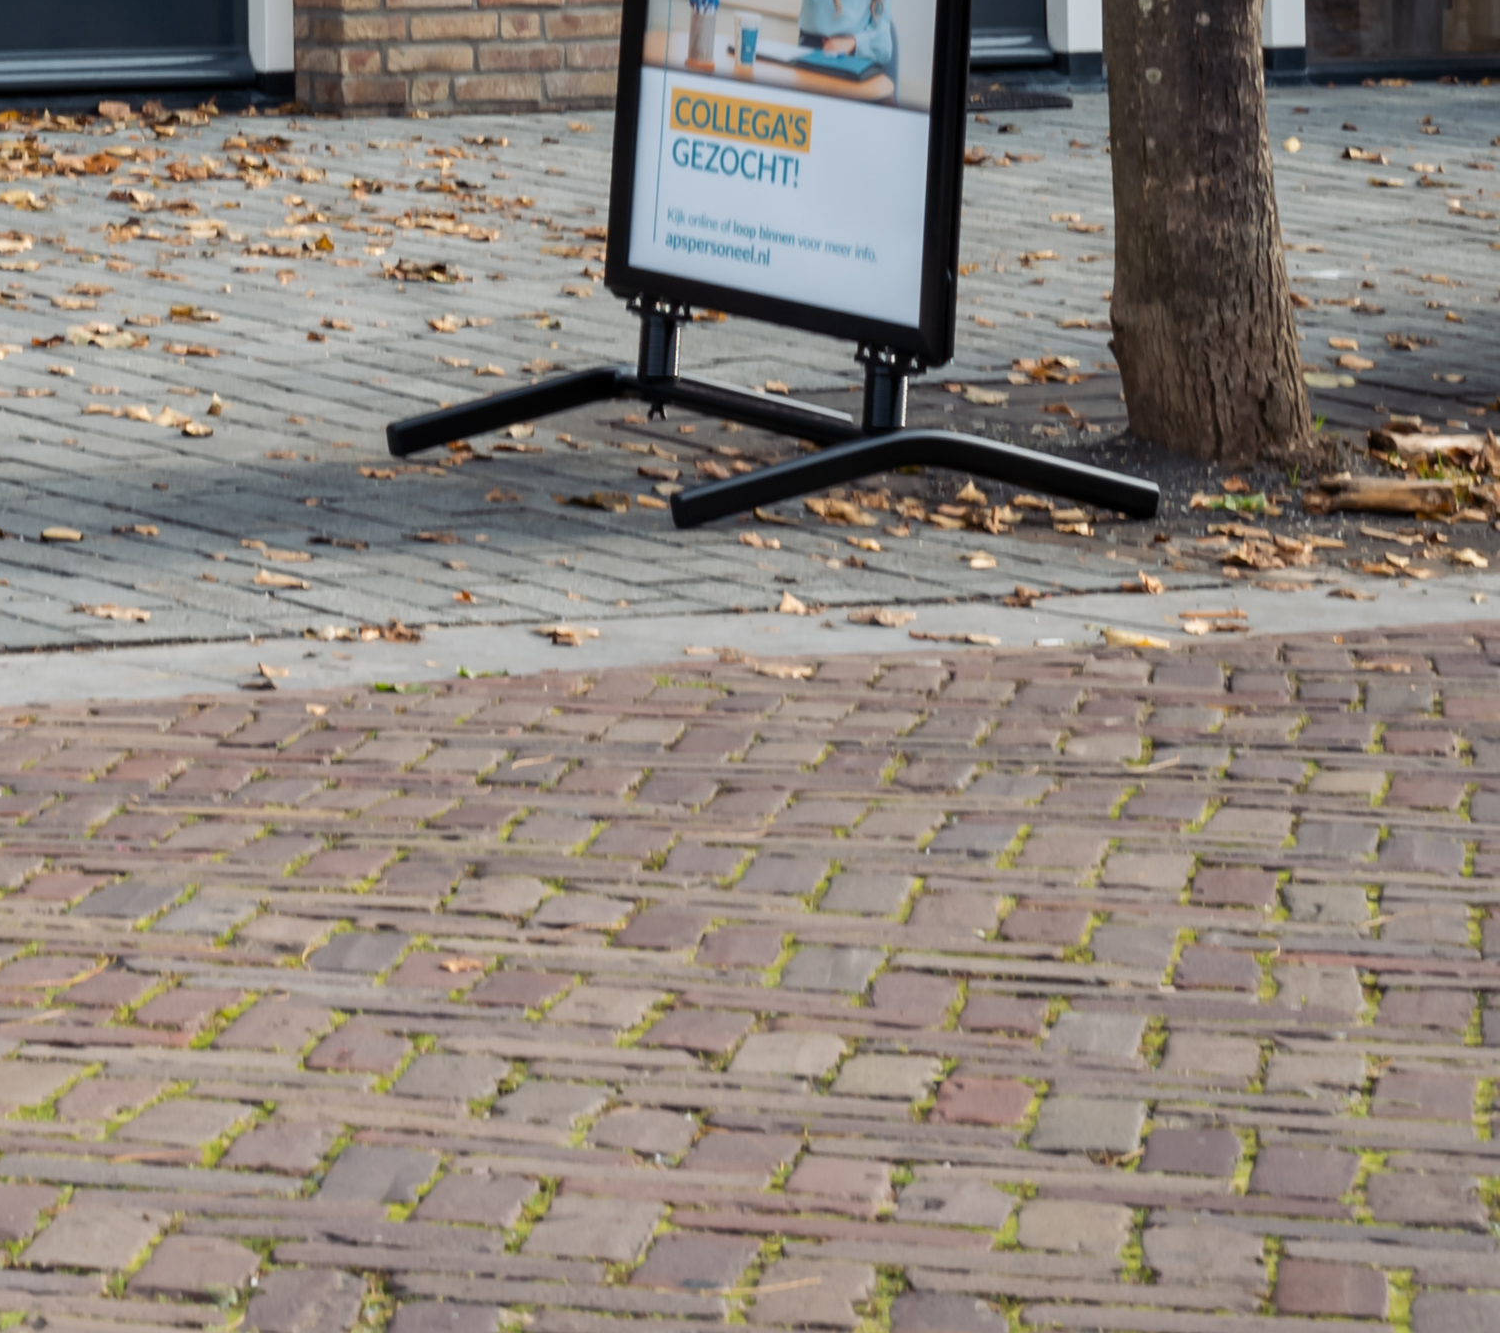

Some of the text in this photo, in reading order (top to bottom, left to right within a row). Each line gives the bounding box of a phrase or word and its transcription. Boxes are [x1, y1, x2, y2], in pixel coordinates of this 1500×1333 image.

[674, 95, 807, 147] COLLEGA'S
[672, 136, 799, 188] GEZOCHT!
[665, 232, 771, 267] apspersoneel.nl
[666, 207, 686, 226] Kijk
[688, 213, 718, 231] online
[721, 219, 731, 232] of
[733, 220, 756, 240] loop
[759, 225, 795, 247] binnen
[798, 237, 821, 251] voor
[824, 242, 851, 257] meer
